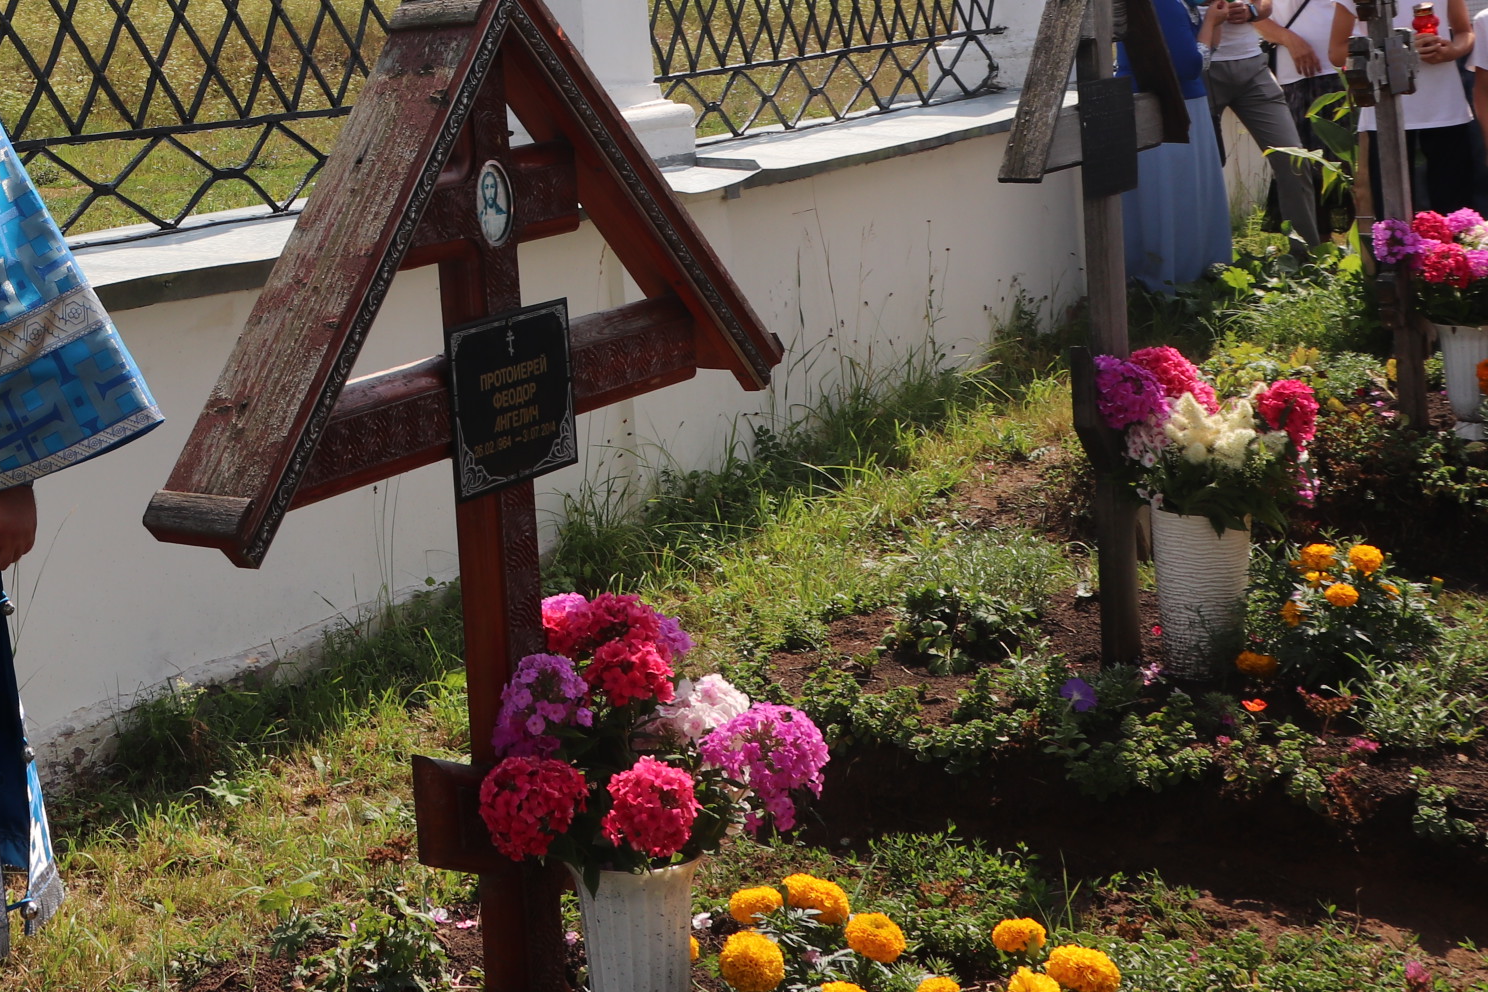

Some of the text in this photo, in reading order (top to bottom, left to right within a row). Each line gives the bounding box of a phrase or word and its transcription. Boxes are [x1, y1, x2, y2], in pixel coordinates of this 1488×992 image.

[480, 354, 547, 392] ПРОТОИЕРЕЙ
[493, 383, 536, 409] ФЕОДОР
[494, 404, 539, 433] АНГЕЛИЧ
